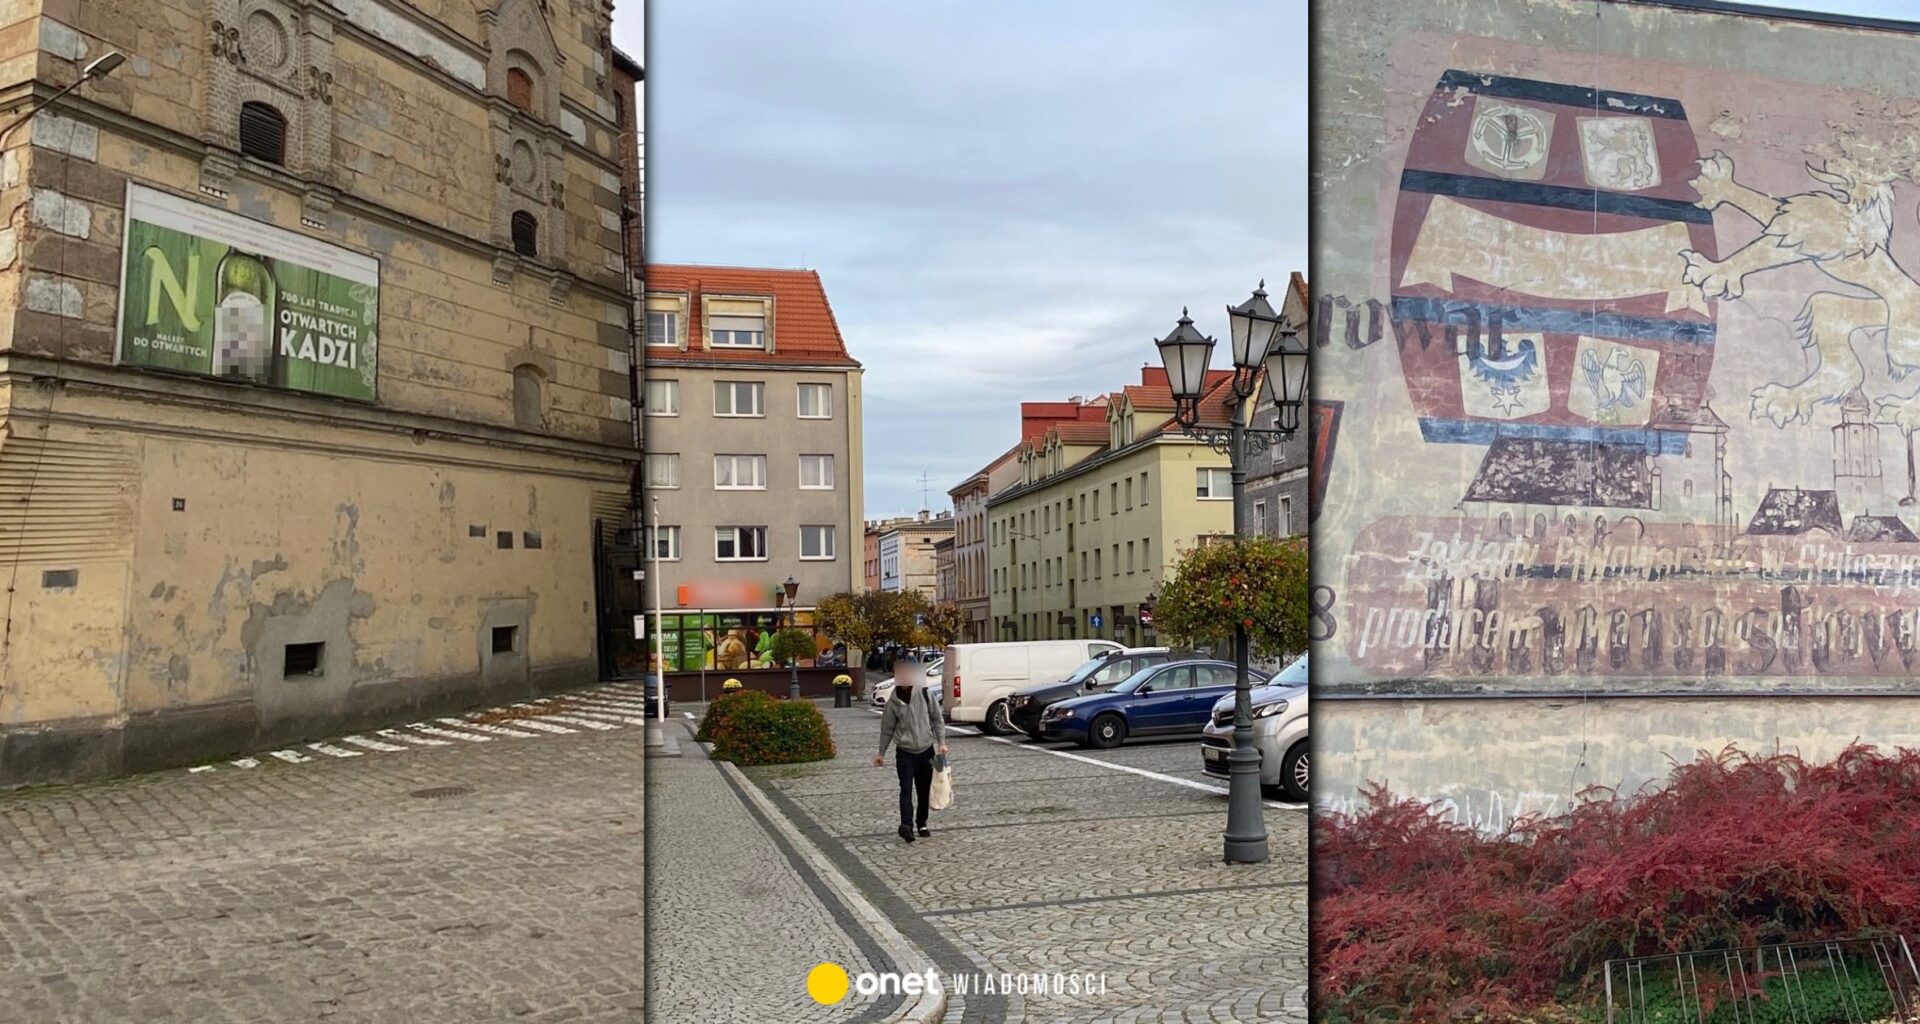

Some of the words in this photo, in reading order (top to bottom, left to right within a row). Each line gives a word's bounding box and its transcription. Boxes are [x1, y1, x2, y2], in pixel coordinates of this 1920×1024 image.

[145, 247, 203, 332] N
[281, 291, 298, 303] 700
[300, 297, 316, 307] LAT
[318, 301, 358, 318] TRADYCJI
[280, 309, 357, 340] OTWARTYCH
[133, 337, 149, 348] DO
[151, 340, 208, 358] OTWARTYCH
[280, 327, 357, 369] KADZI
